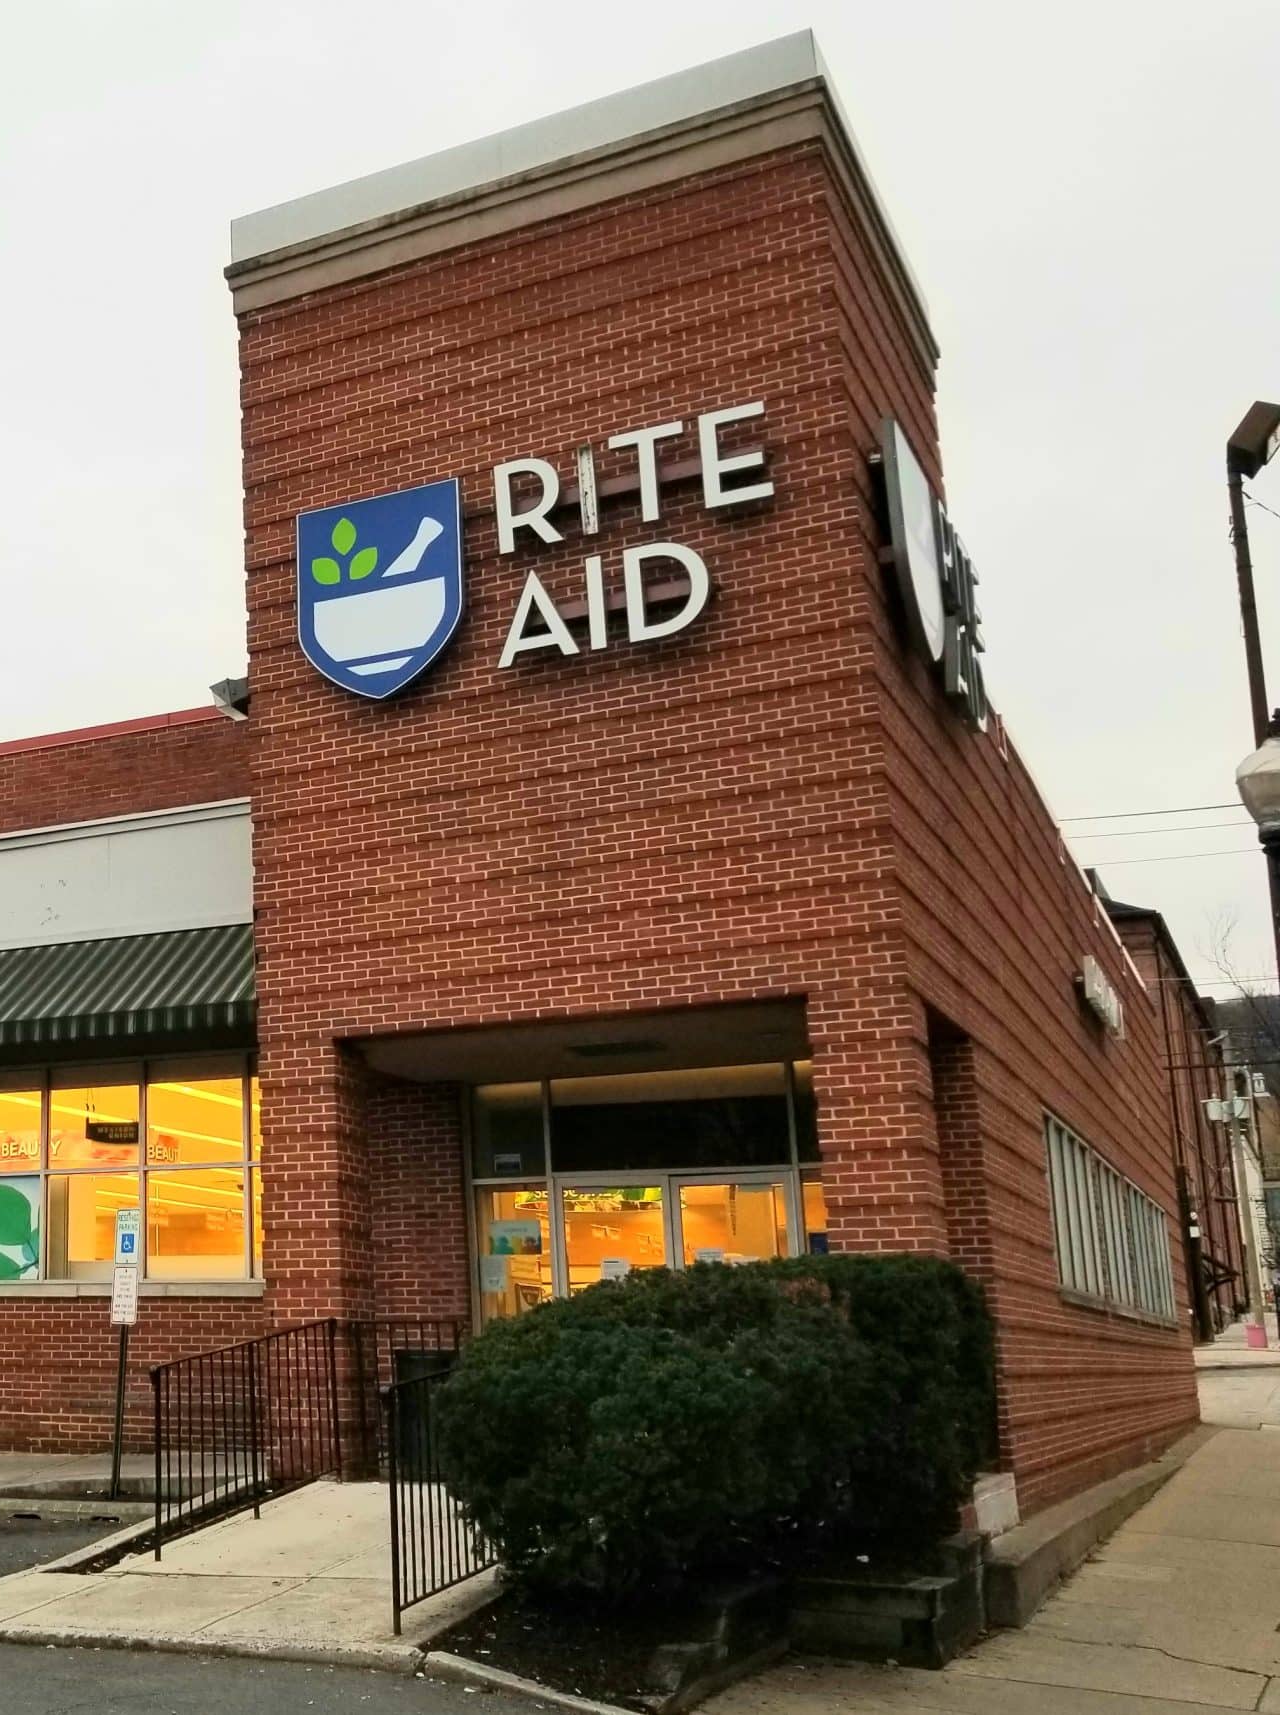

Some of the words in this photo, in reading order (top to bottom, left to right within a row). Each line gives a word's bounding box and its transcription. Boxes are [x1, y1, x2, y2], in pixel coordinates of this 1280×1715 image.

[493, 400, 775, 554] RITE
[497, 542, 712, 669] AID
[1, 1139, 62, 1157] BEAUY
